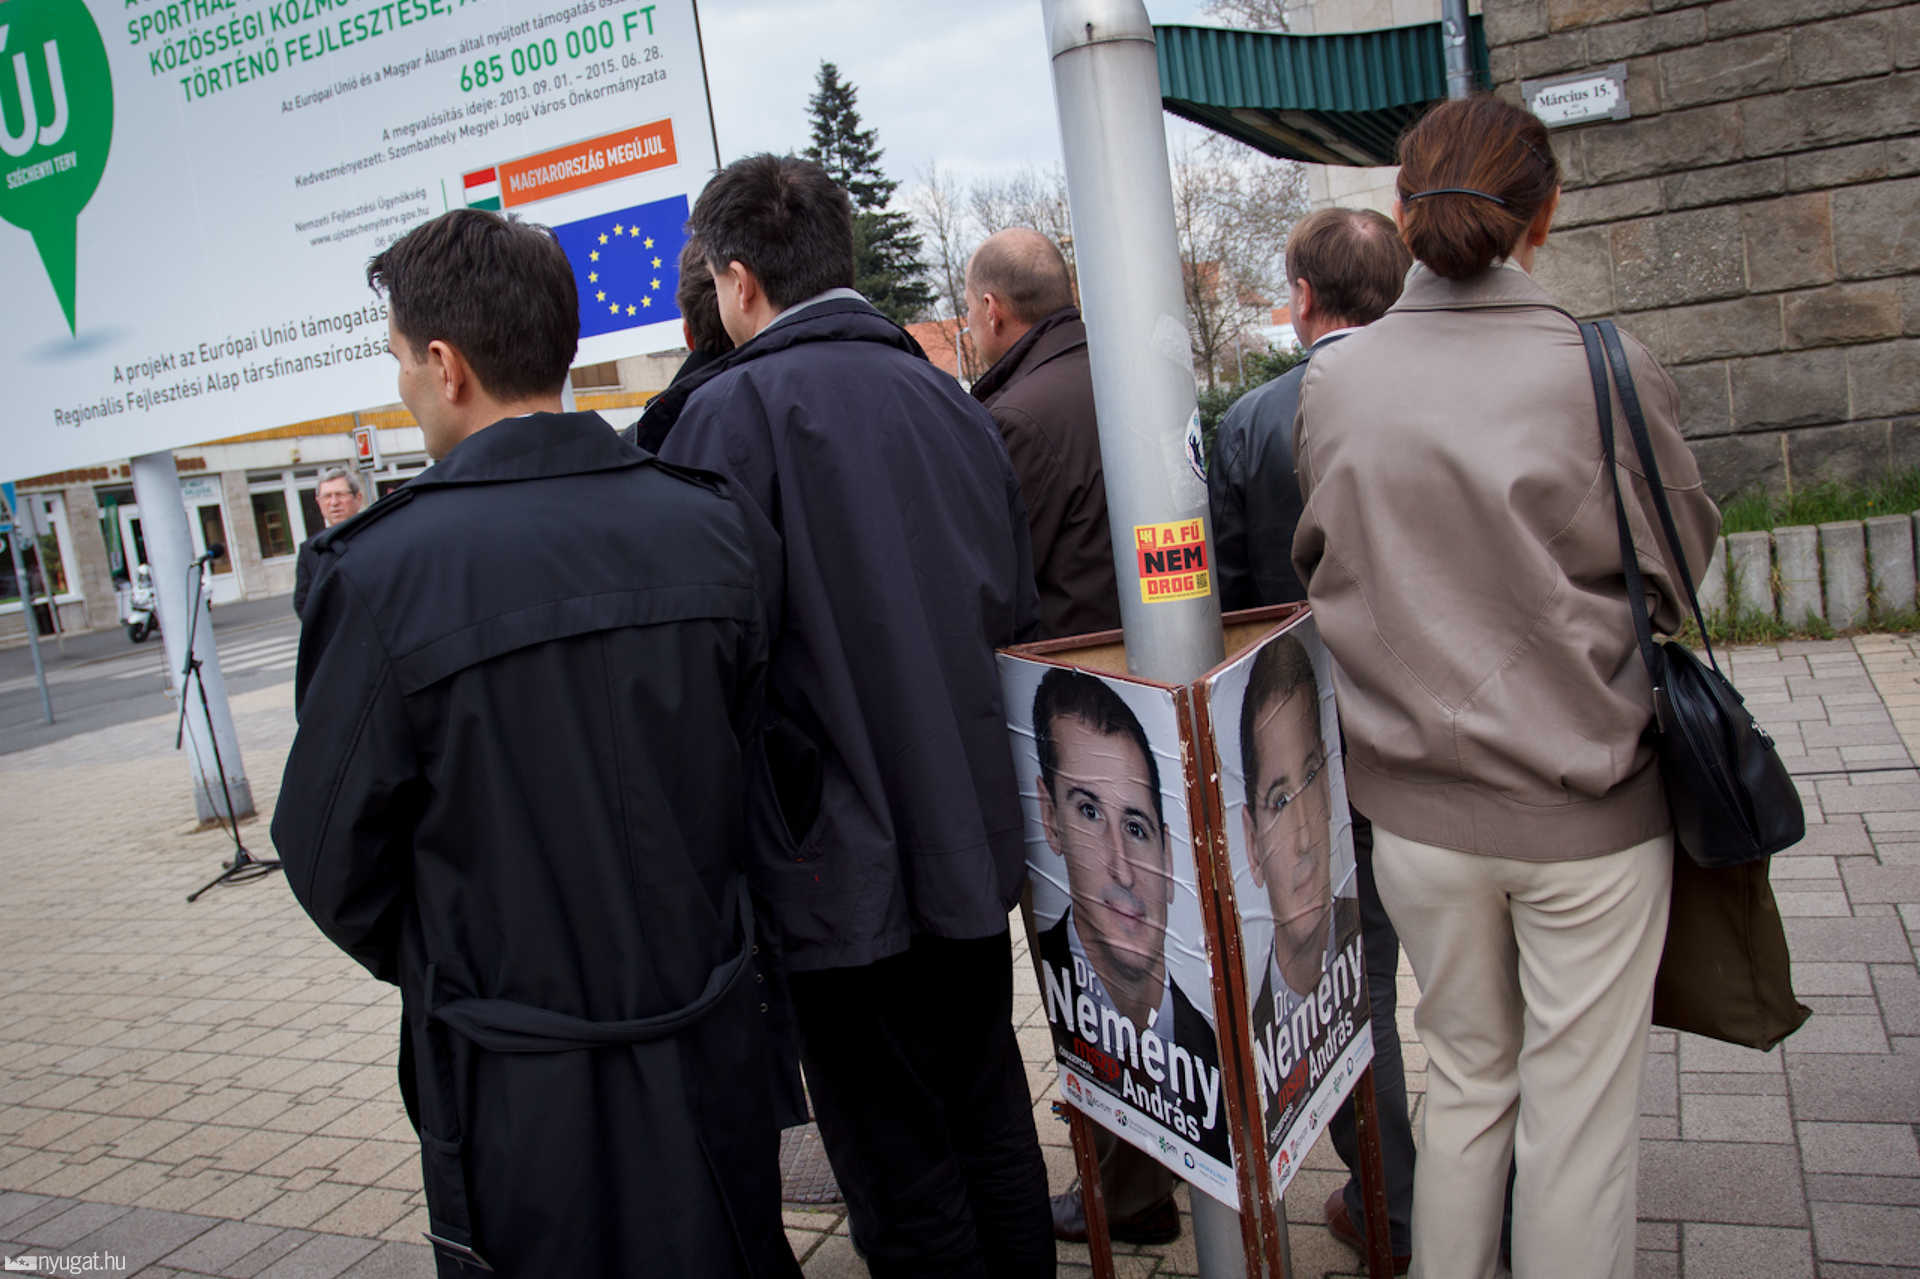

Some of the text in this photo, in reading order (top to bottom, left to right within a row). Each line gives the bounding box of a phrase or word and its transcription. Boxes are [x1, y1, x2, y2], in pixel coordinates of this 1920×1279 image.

[149, 11, 264, 76] KÖZÖSSÉGI
[180, 37, 279, 102] TÖRTÉNŐ
[281, 3, 596, 113] Az Európai Unió és a Magyar Állam által nyújtott támogatás
[460, 5, 656, 93] 685 000 000 FT
[382, 128, 391, 142] A
[392, 106, 466, 140] megvalósítás
[466, 96, 498, 119] ideje:
[500, 86, 530, 107] 2013.
[533, 80, 553, 98] 09.
[554, 73, 574, 92] 01.
[585, 59, 620, 83] 2015.
[622, 52, 642, 71] 06.
[644, 45, 664, 66] 28.
[1539, 90, 1589, 108] Március
[1593, 83, 1611, 98] 15.
[295, 68, 667, 188] Kedvezményezett: Szombathely Megyei Jogú Város Önkormányzata
[6, 151, 77, 189] SZÉCHENYI TERV
[510, 134, 667, 193] MAGYARORSZÁG MEGÚJUL
[295, 217, 329, 233] Nemzeti
[113, 365, 123, 384] A
[126, 348, 176, 384] projekt
[179, 351, 195, 368] az
[199, 331, 258, 363] Európai
[261, 320, 297, 348] Unió
[54, 394, 124, 428] Regionális
[126, 374, 203, 413] Fejlesztési
[206, 363, 240, 393] Alap
[1144, 545, 1203, 574] NEM
[1163, 529, 1175, 544] A
[1147, 575, 1195, 596] DROG
[1073, 955, 1101, 997] Dr.
[1274, 988, 1293, 1028] Dr.
[1041, 958, 1221, 1130] Nemény
[1255, 934, 1363, 1113] Nemény
[1308, 1008, 1354, 1089] András
[1122, 1068, 1201, 1143] András
